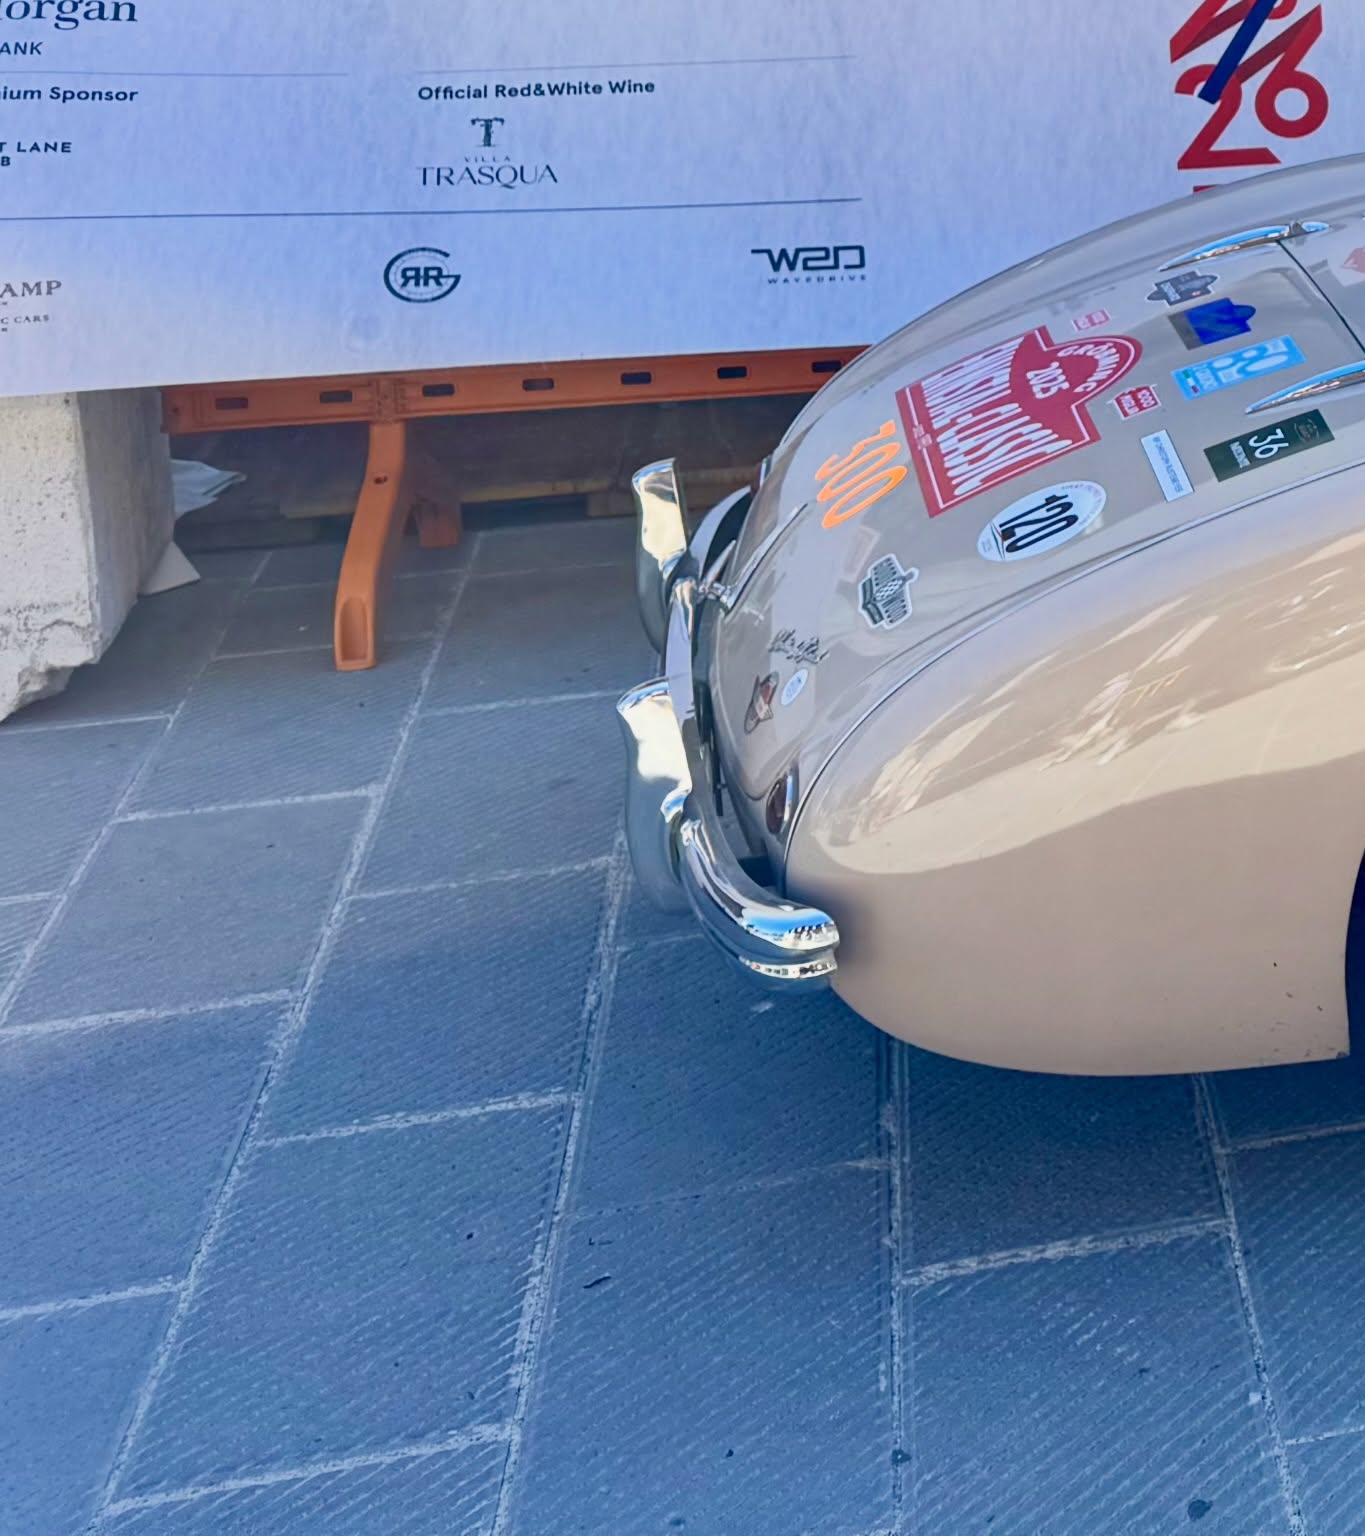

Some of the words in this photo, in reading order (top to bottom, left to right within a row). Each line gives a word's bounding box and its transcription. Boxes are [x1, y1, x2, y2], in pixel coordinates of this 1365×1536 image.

[0, 86, 42, 101] ium
[50, 86, 138, 103] Sponsor
[418, 84, 488, 101] Official
[495, 81, 603, 99] Red&White
[608, 79, 655, 94] Wine
[17, 141, 72, 153] LANE
[465, 155, 511, 163] VILLA
[416, 164, 558, 189] TRASQUA
[1026, 361, 1070, 400] 2025
[1248, 428, 1290, 459] 36
[815, 419, 908, 529] 300
[999, 494, 1079, 553] 120
